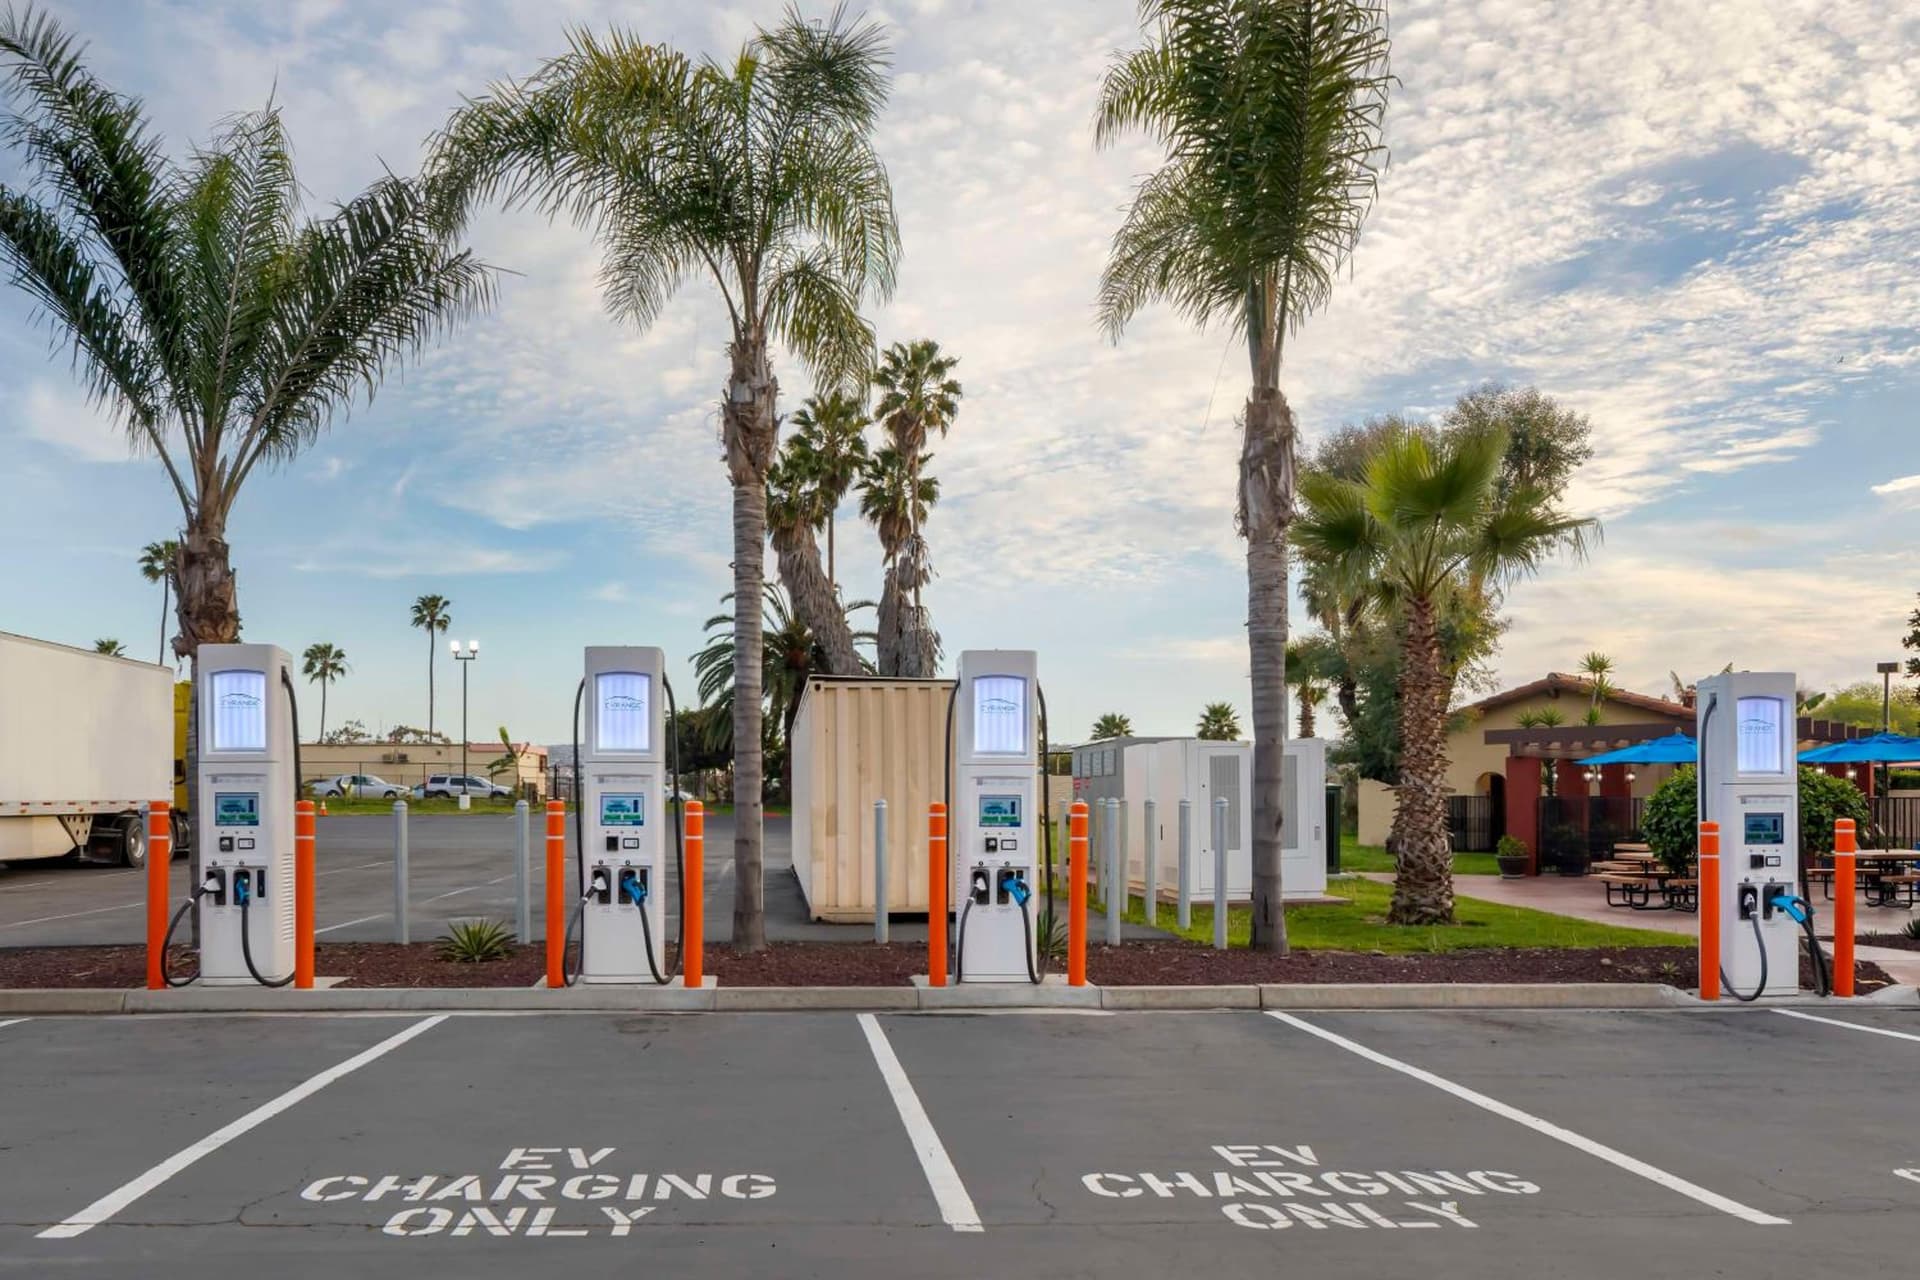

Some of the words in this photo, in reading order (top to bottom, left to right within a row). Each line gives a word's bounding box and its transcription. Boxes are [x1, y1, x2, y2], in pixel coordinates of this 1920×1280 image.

[500, 1148, 614, 1169] EV
[1212, 1146, 1318, 1166] EV
[301, 1174, 776, 1200] CHARGING
[1082, 1171, 1540, 1197] CHARGING
[383, 1207, 655, 1235] ONLY
[1222, 1202, 1478, 1229] ONLY
